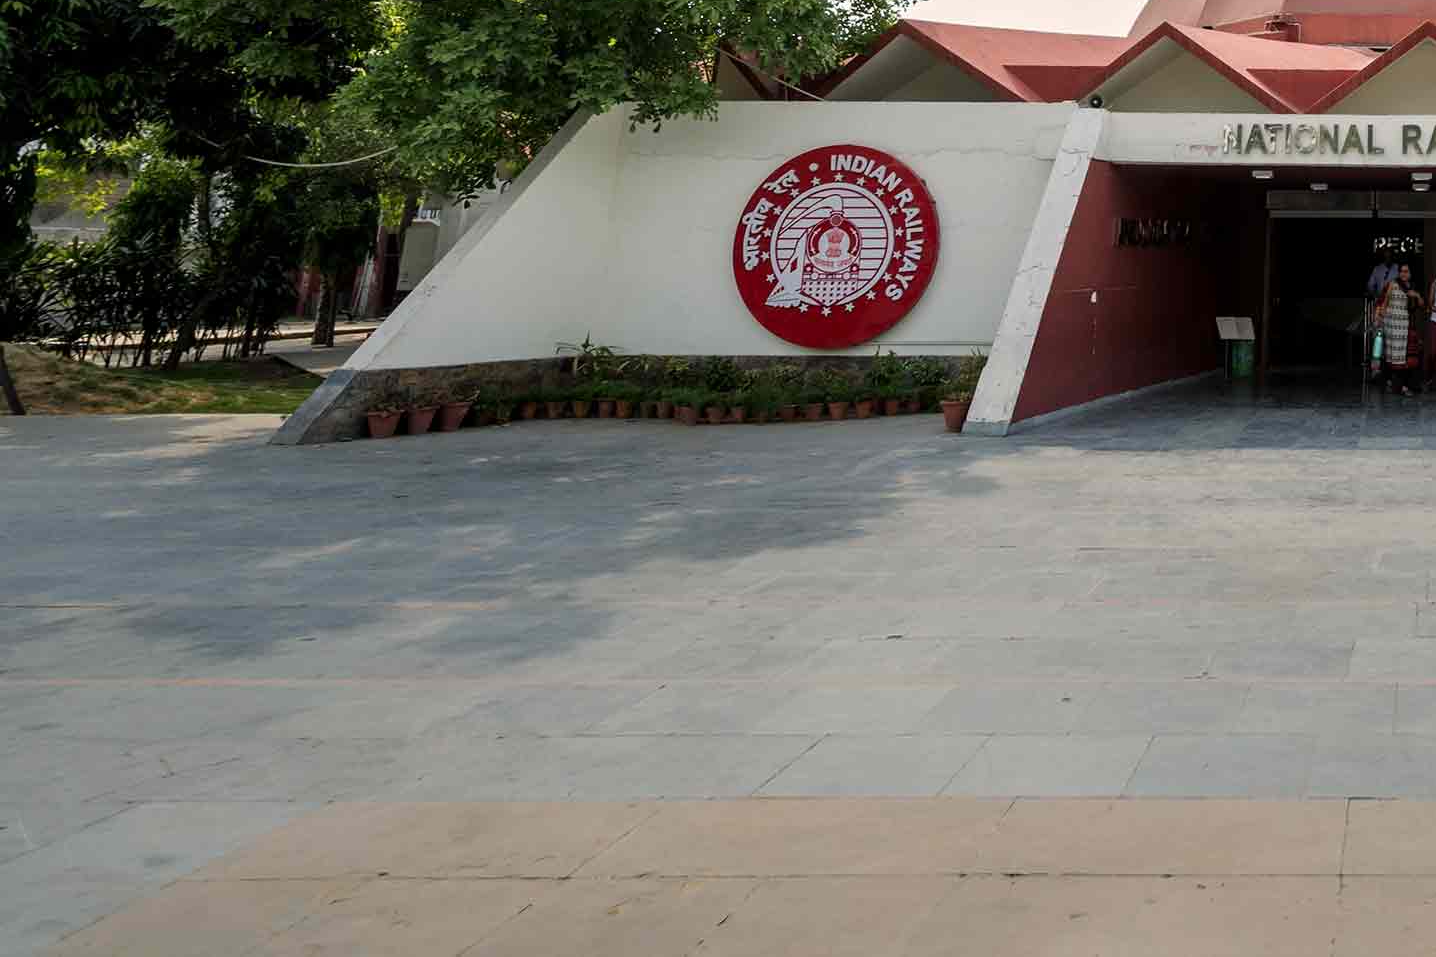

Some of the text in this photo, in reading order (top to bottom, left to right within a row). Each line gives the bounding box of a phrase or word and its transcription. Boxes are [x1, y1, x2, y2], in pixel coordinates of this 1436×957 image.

[1223, 123, 1385, 154] NATIONAL
[742, 169, 801, 271] भारतीय रेल
[830, 154, 903, 192] INDIAN
[885, 188, 925, 302] RAILWAYS
